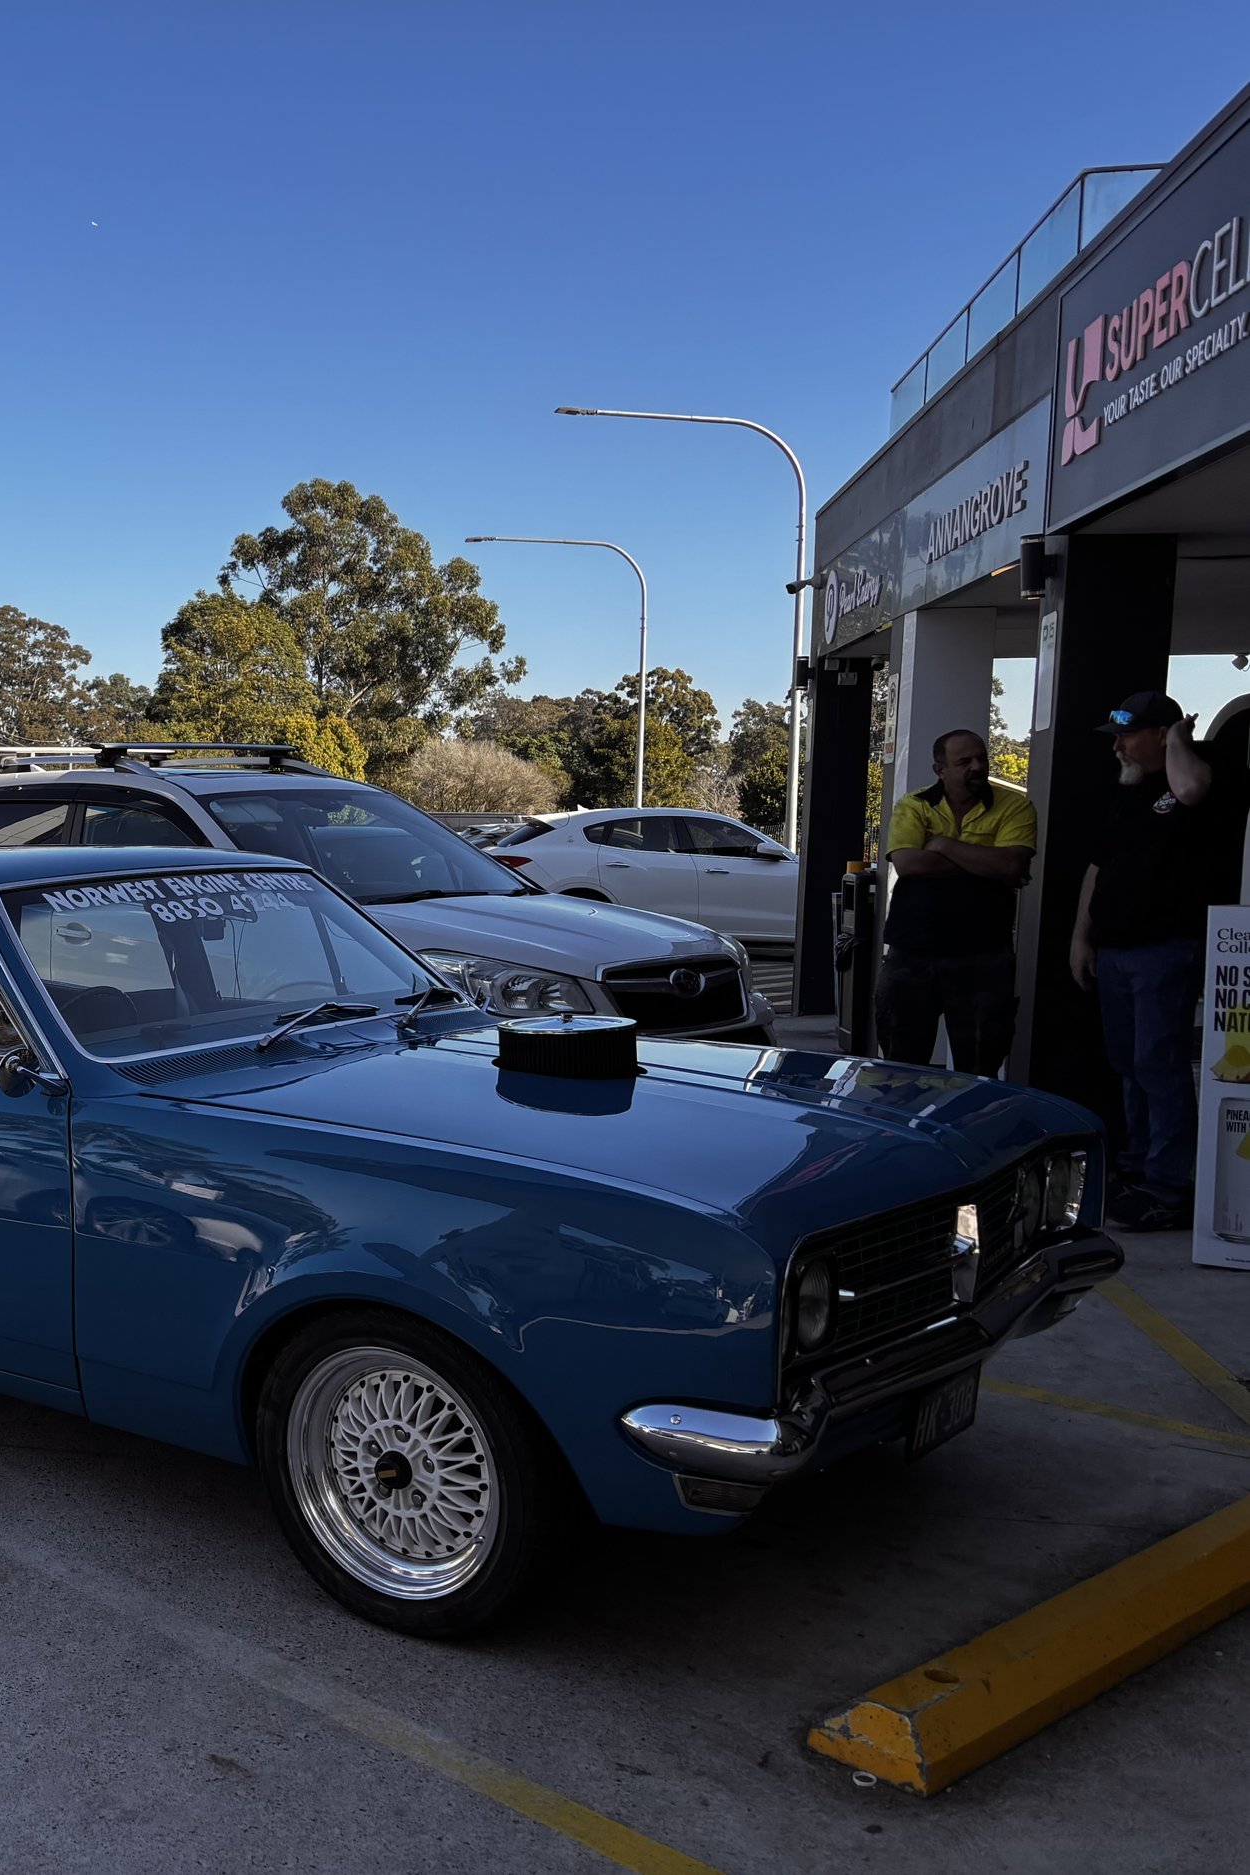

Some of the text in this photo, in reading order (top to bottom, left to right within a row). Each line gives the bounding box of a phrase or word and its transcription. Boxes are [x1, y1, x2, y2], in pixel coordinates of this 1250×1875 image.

[1105, 216, 1250, 382] SUPERCEL
[1103, 311, 1249, 427] YOUR TASTE. OUR SPECIALTY.
[927, 460, 1029, 565] ANNANGROVE
[839, 572, 859, 618] Pearl
[42, 873, 314, 912] NORWEST ENGINE CENTRE
[151, 892, 297, 923] 8850 4244
[1215, 965, 1239, 987] NO
[1214, 988, 1238, 1009] NO
[1226, 1121, 1247, 1133] WITH
